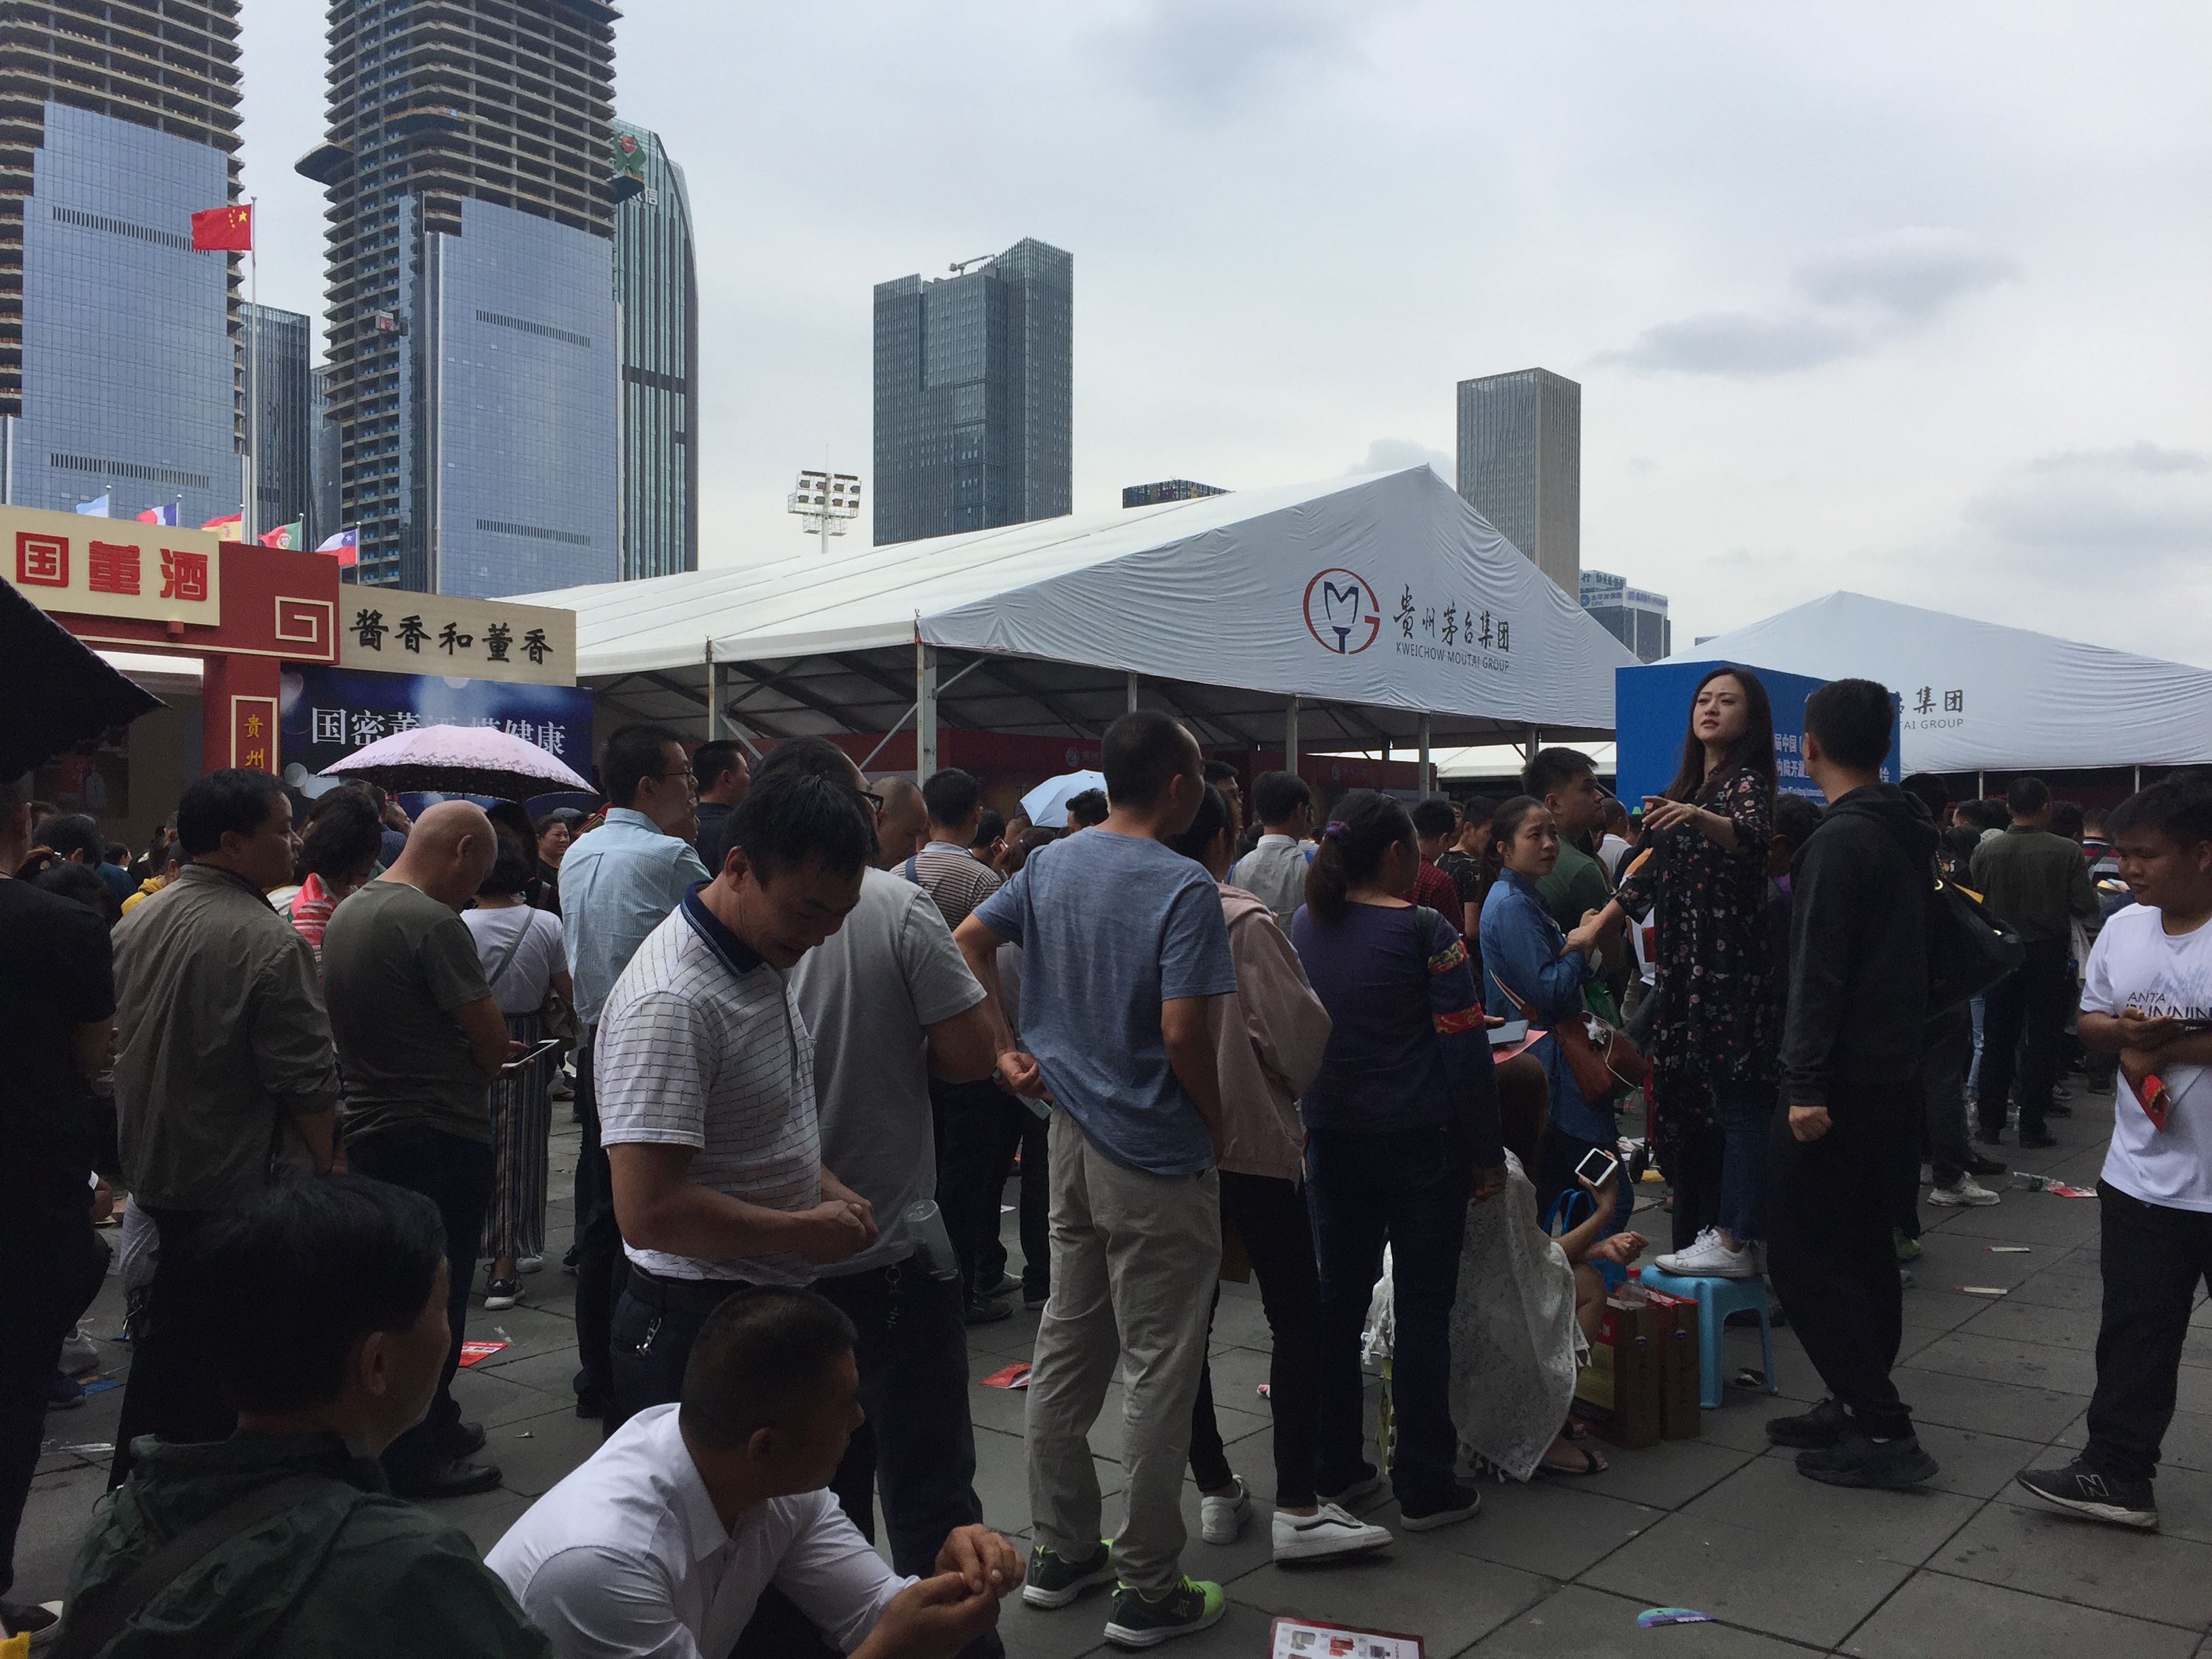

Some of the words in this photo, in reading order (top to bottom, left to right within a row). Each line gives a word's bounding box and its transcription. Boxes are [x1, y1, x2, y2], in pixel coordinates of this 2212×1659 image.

[16, 531, 208, 602] 国董酒
[1396, 641, 1445, 661] KWEICHOW
[1448, 651, 1480, 668] MOUTAI
[1483, 657, 1510, 672] GROUP
[1921, 718, 1963, 729] GROUP
[244, 714, 264, 769] 贵州
[2128, 991, 2166, 1004] ANTA
[2076, 1474, 2110, 1497] N
